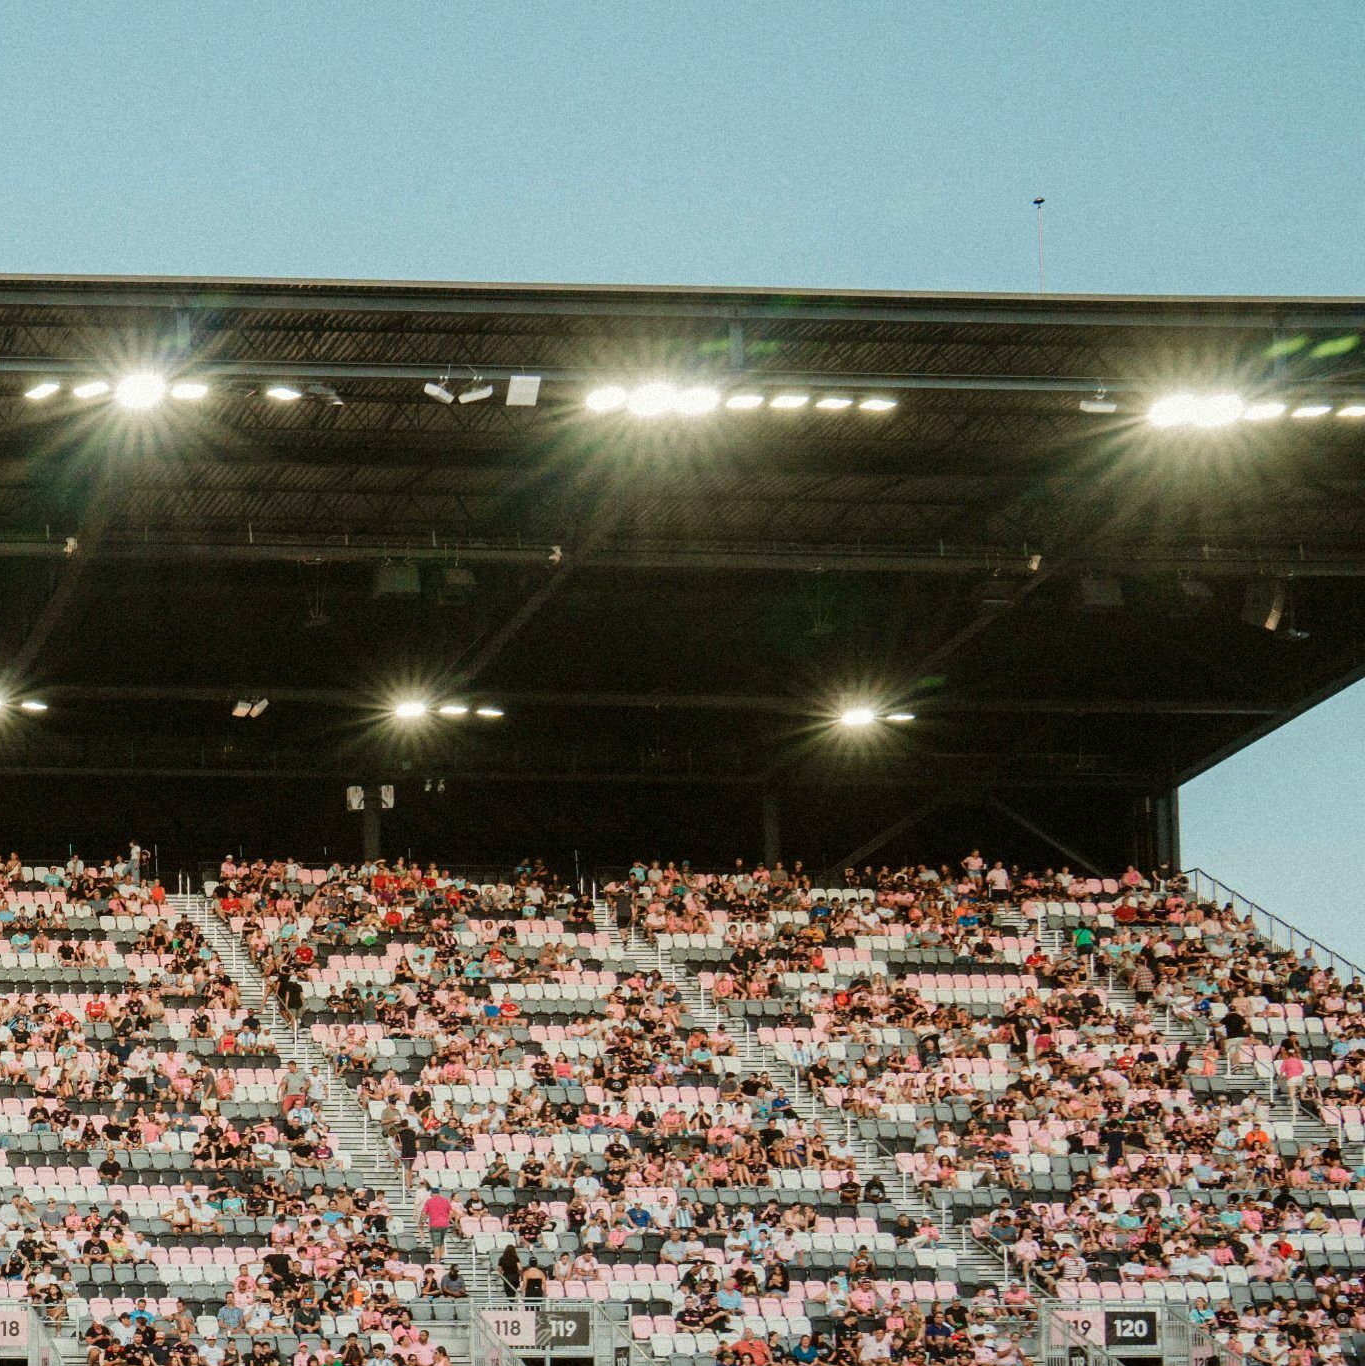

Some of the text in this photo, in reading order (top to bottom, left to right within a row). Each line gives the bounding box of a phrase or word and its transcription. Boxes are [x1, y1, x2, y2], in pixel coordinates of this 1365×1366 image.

[494, 1320, 521, 1336] 118
[549, 1321, 577, 1337] 119
[1113, 1319, 1148, 1338] 120
